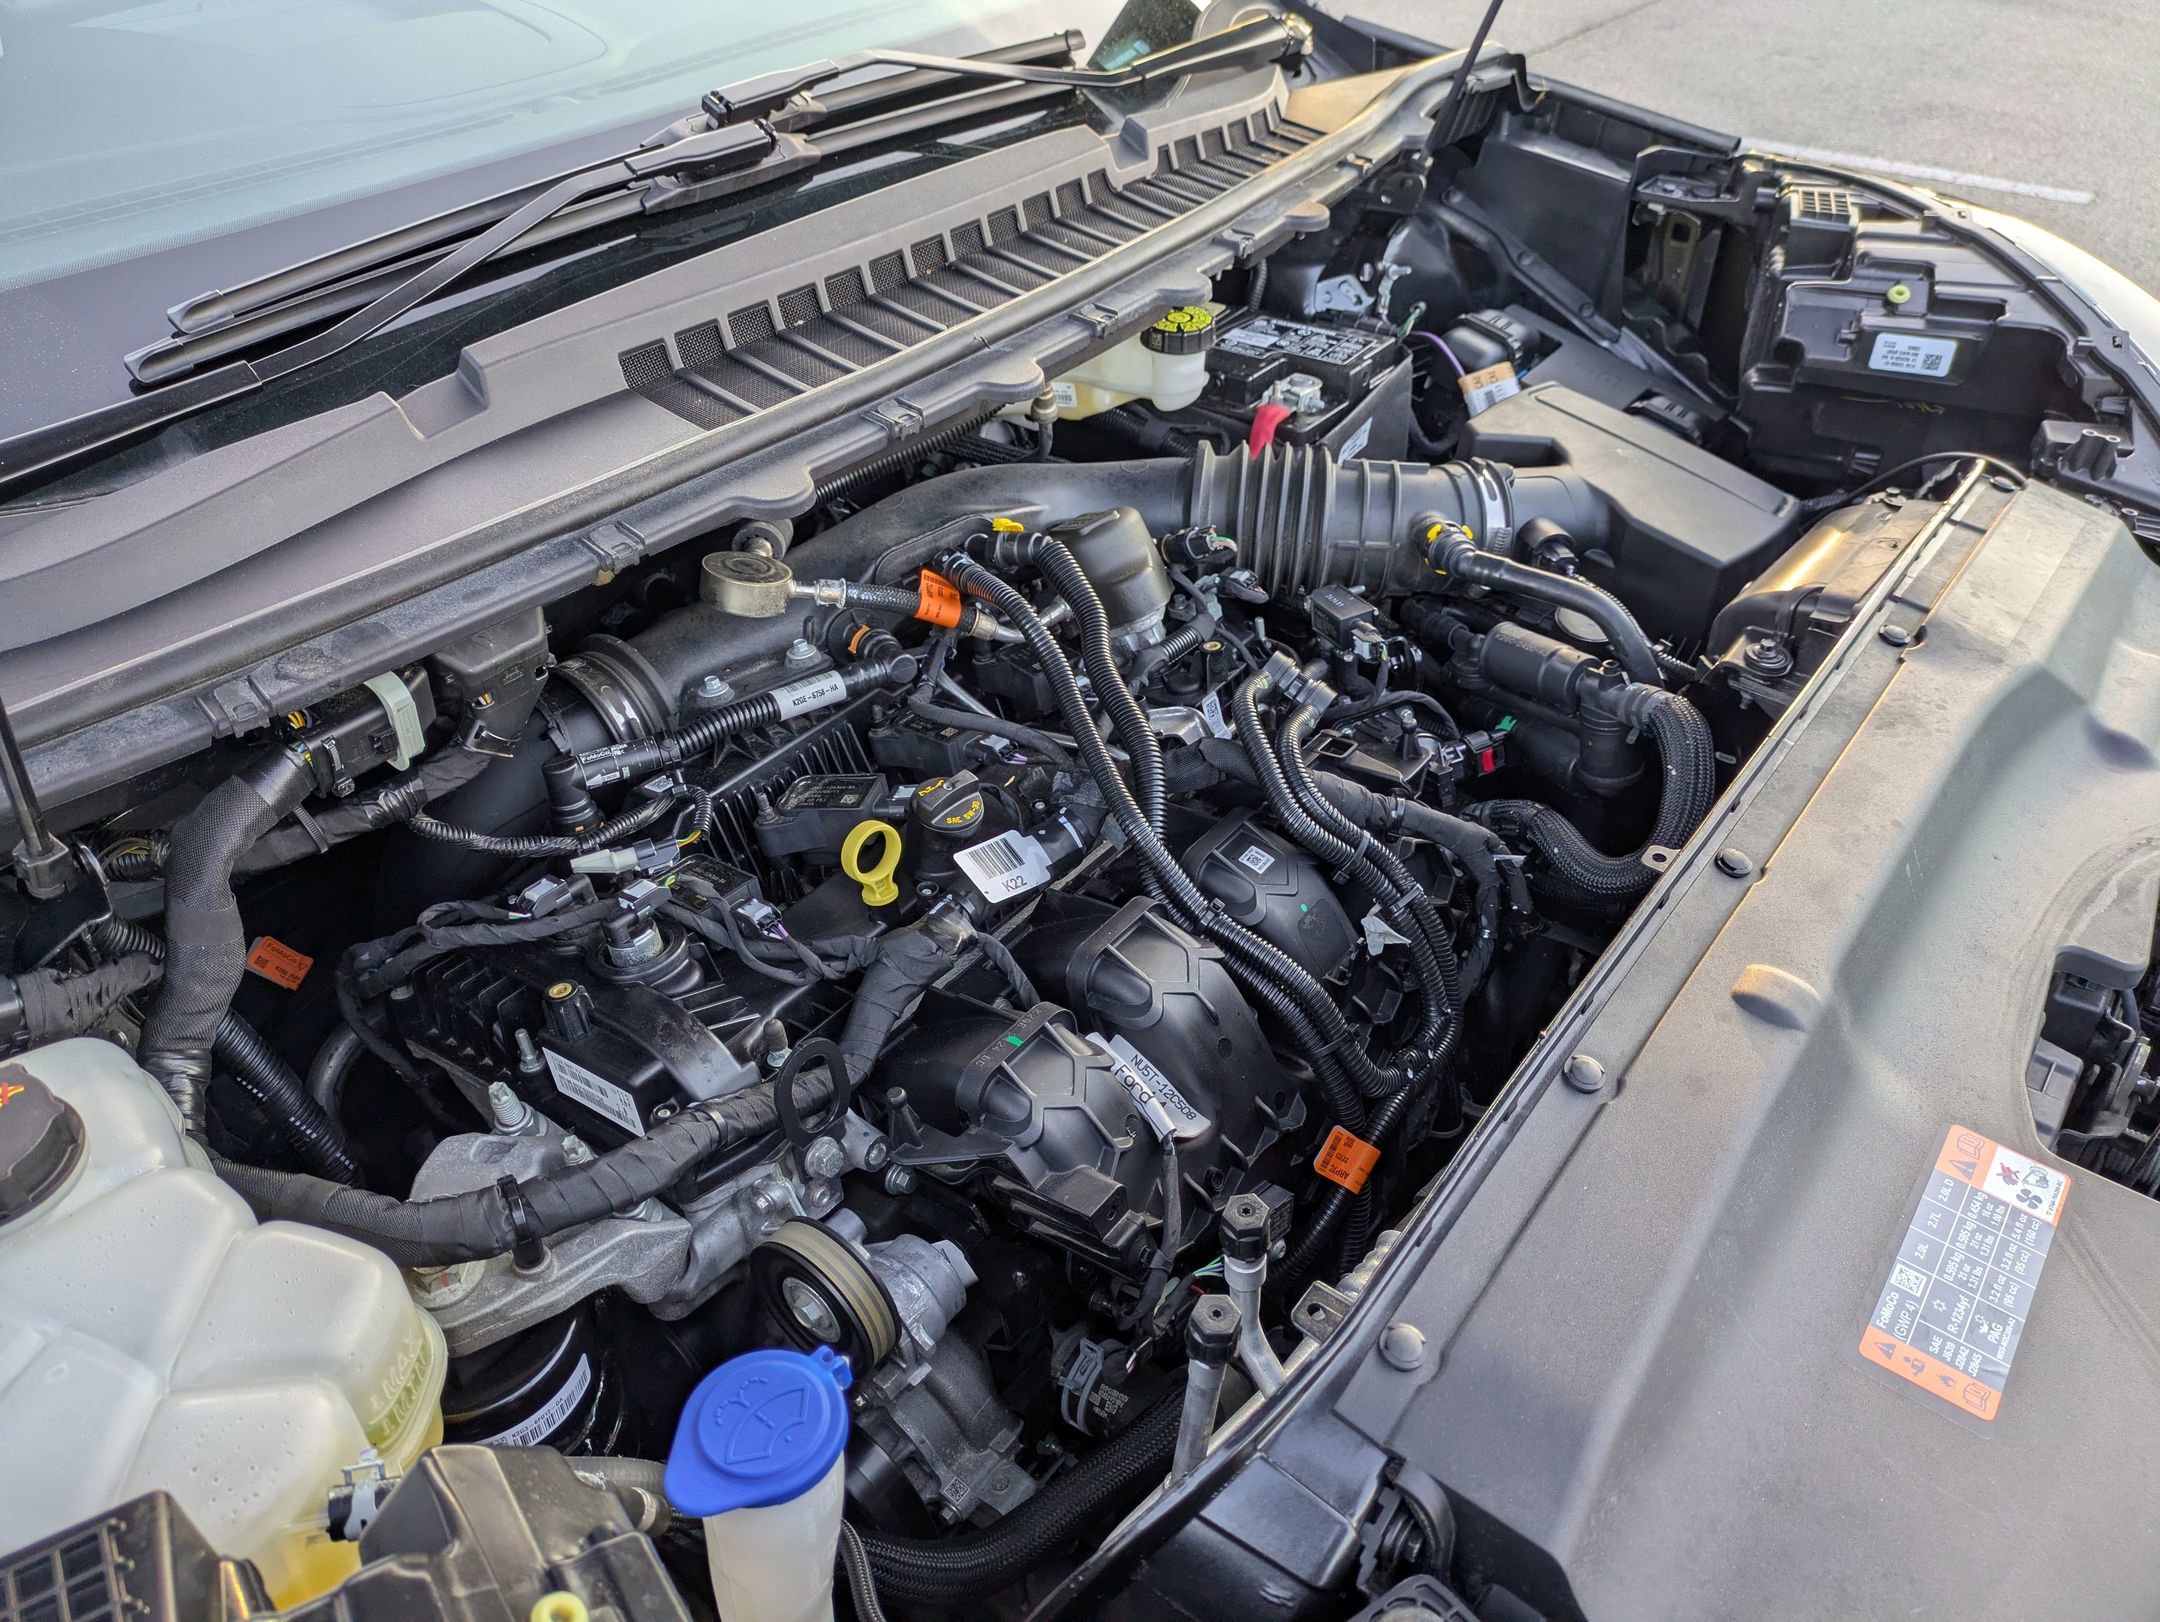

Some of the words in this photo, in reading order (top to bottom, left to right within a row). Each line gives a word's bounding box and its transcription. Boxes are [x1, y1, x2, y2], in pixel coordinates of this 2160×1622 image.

[946, 816, 963, 825] SAE
[963, 800, 980, 821] 5W-30
[1001, 875, 1028, 893] K22
[265, 942, 298, 964] FoMoCo
[1114, 1063, 1156, 1105] Ford
[1130, 1053, 1198, 1121] NU5T-12C508
[1938, 1186, 1952, 1203] 2.0L
[1927, 1211, 1942, 1229] 2.7L
[1967, 1202, 1983, 1220] 0.454
[1914, 1242, 1929, 1260] 2.0L
[1943, 1263, 1959, 1282] 0.595
[2000, 1256, 2011, 1271] 3.2
[1988, 1289, 1998, 1303] 3.2
[1876, 1291, 1899, 1328] FoMoCo
[1947, 1294, 1971, 1334] R-1234yf
[1893, 1310, 1911, 1341] (GWP
[1987, 1322, 2003, 1345] PAG
[1929, 1334, 1943, 1354] SAE
[1942, 1342, 1956, 1362] J639
[1955, 1346, 1970, 1371] J2842
[1967, 1352, 1982, 1377] J2845
